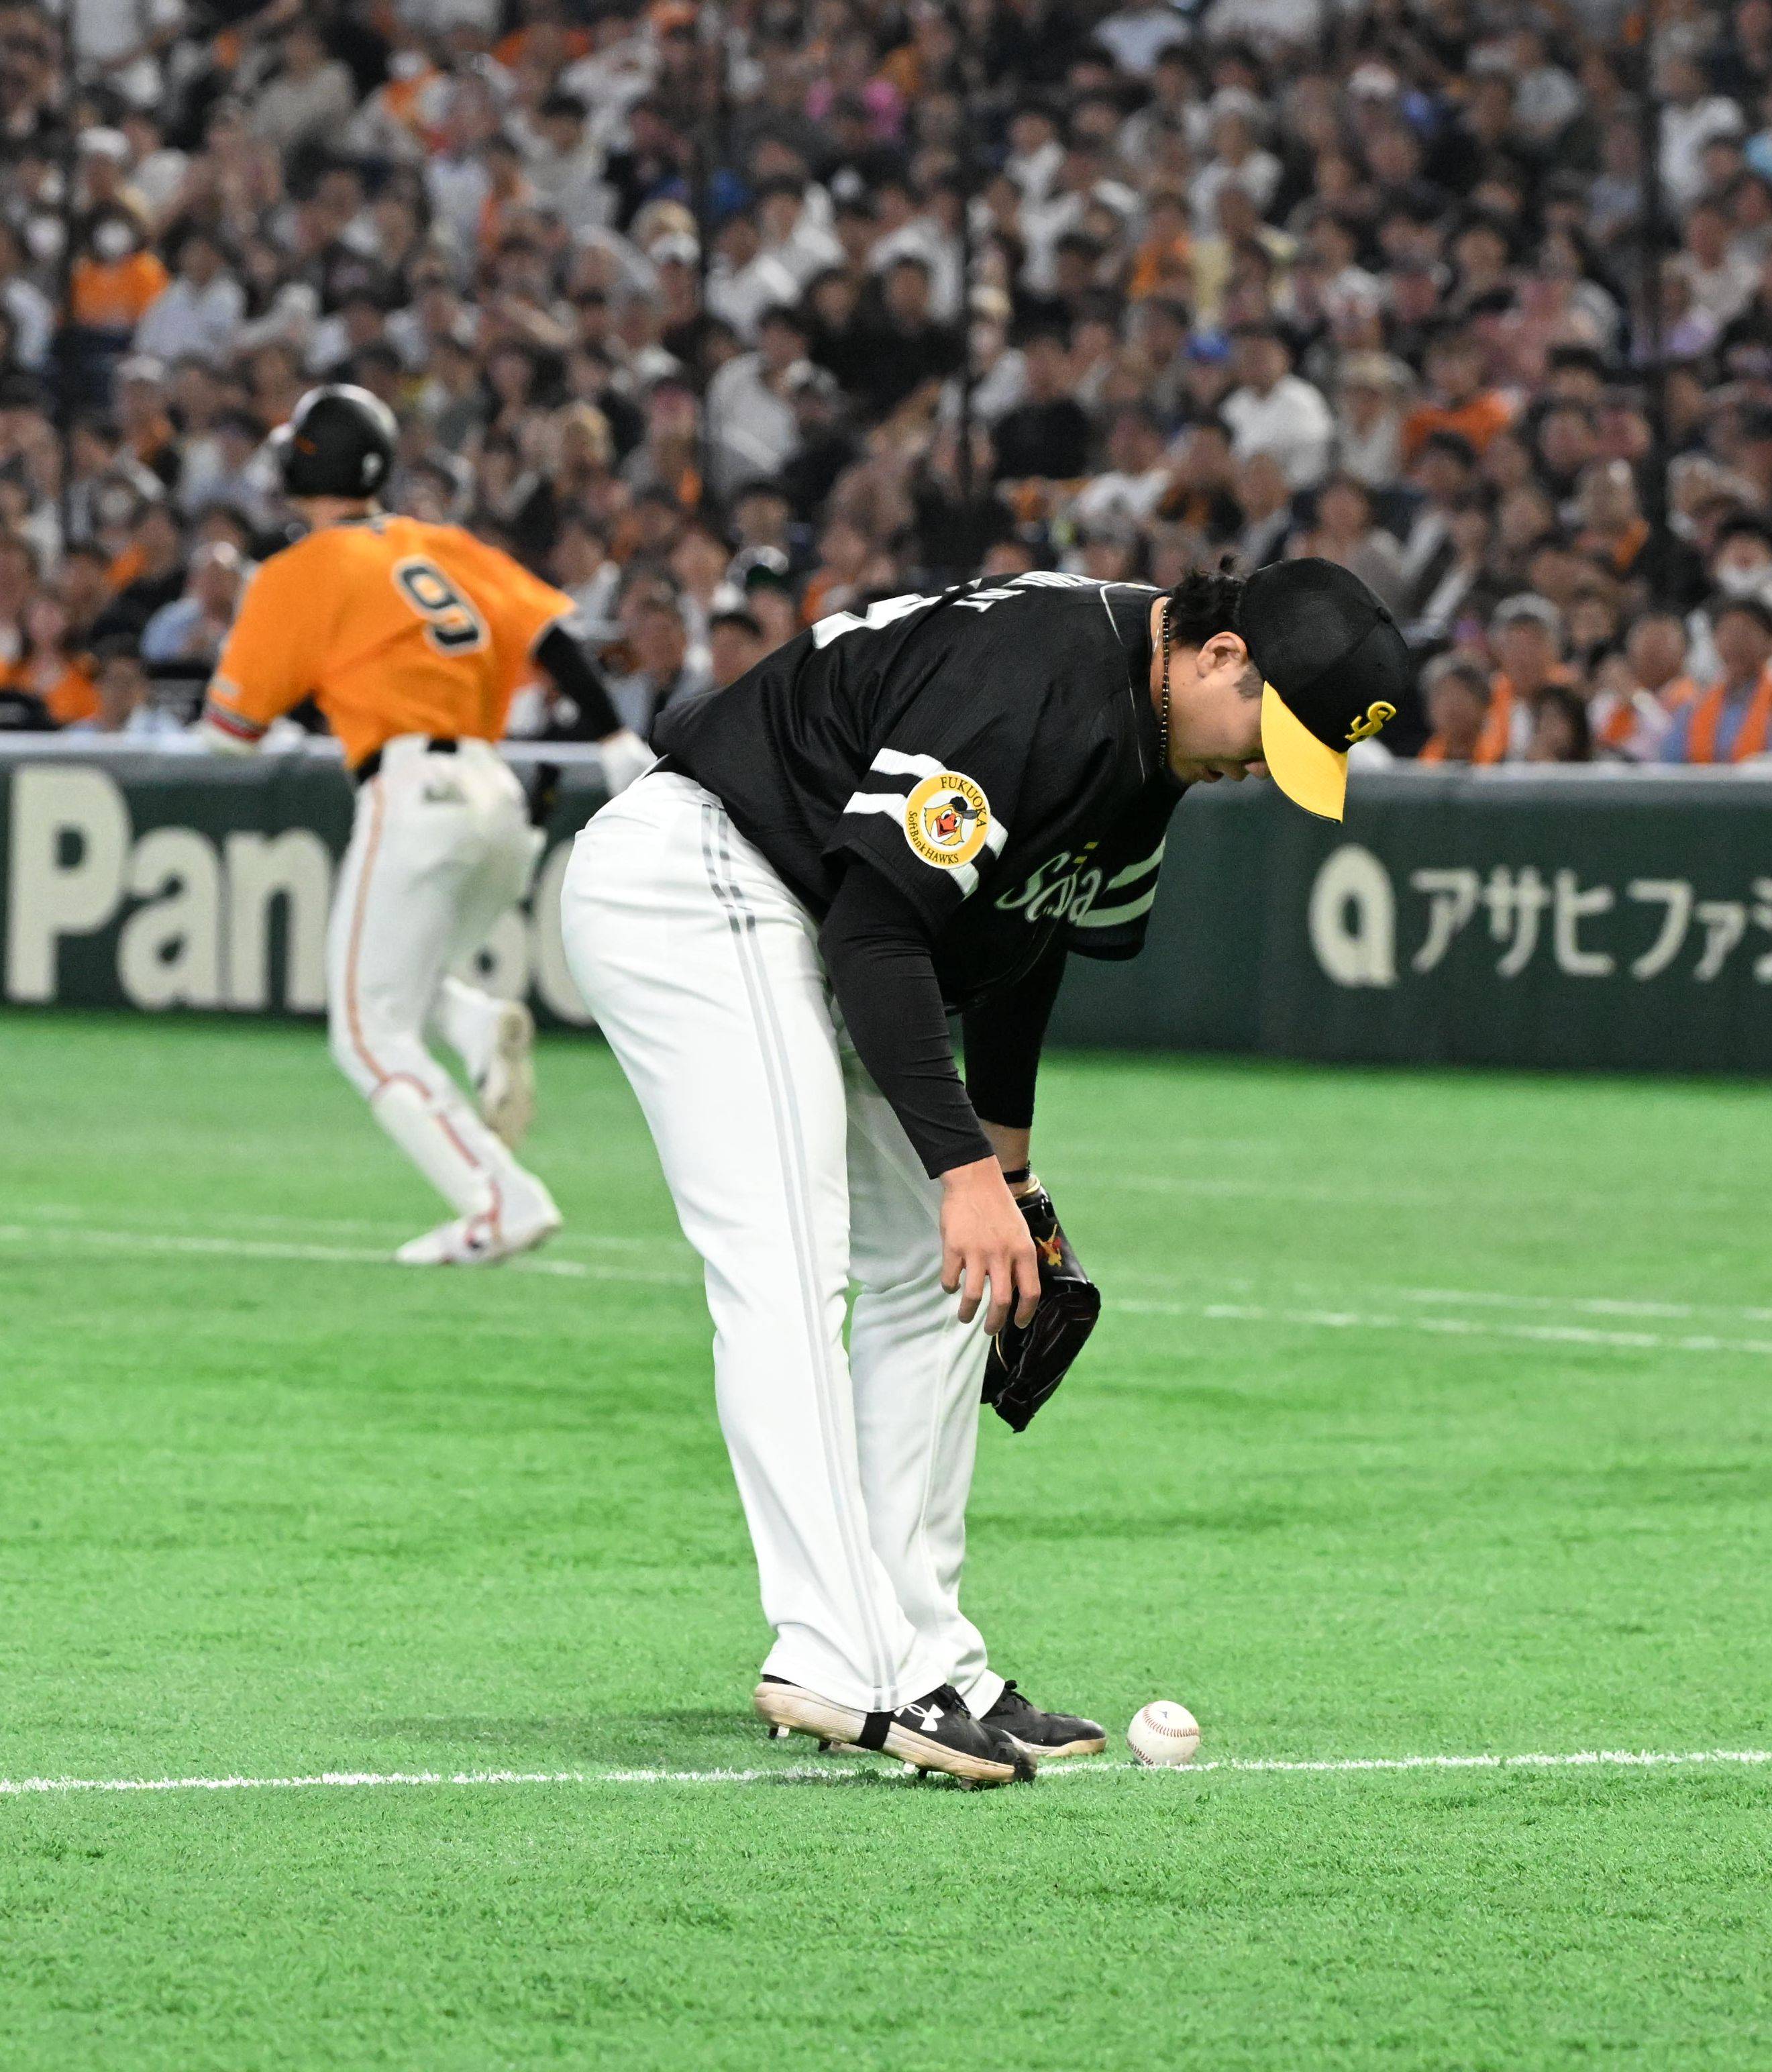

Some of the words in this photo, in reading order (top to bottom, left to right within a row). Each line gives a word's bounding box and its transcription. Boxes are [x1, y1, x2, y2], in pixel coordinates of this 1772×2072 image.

[392, 554, 491, 657] 9
[940, 776, 987, 828] FUKUOKA
[908, 810, 927, 853] SoftBank
[925, 847, 959, 864] HAWKS
